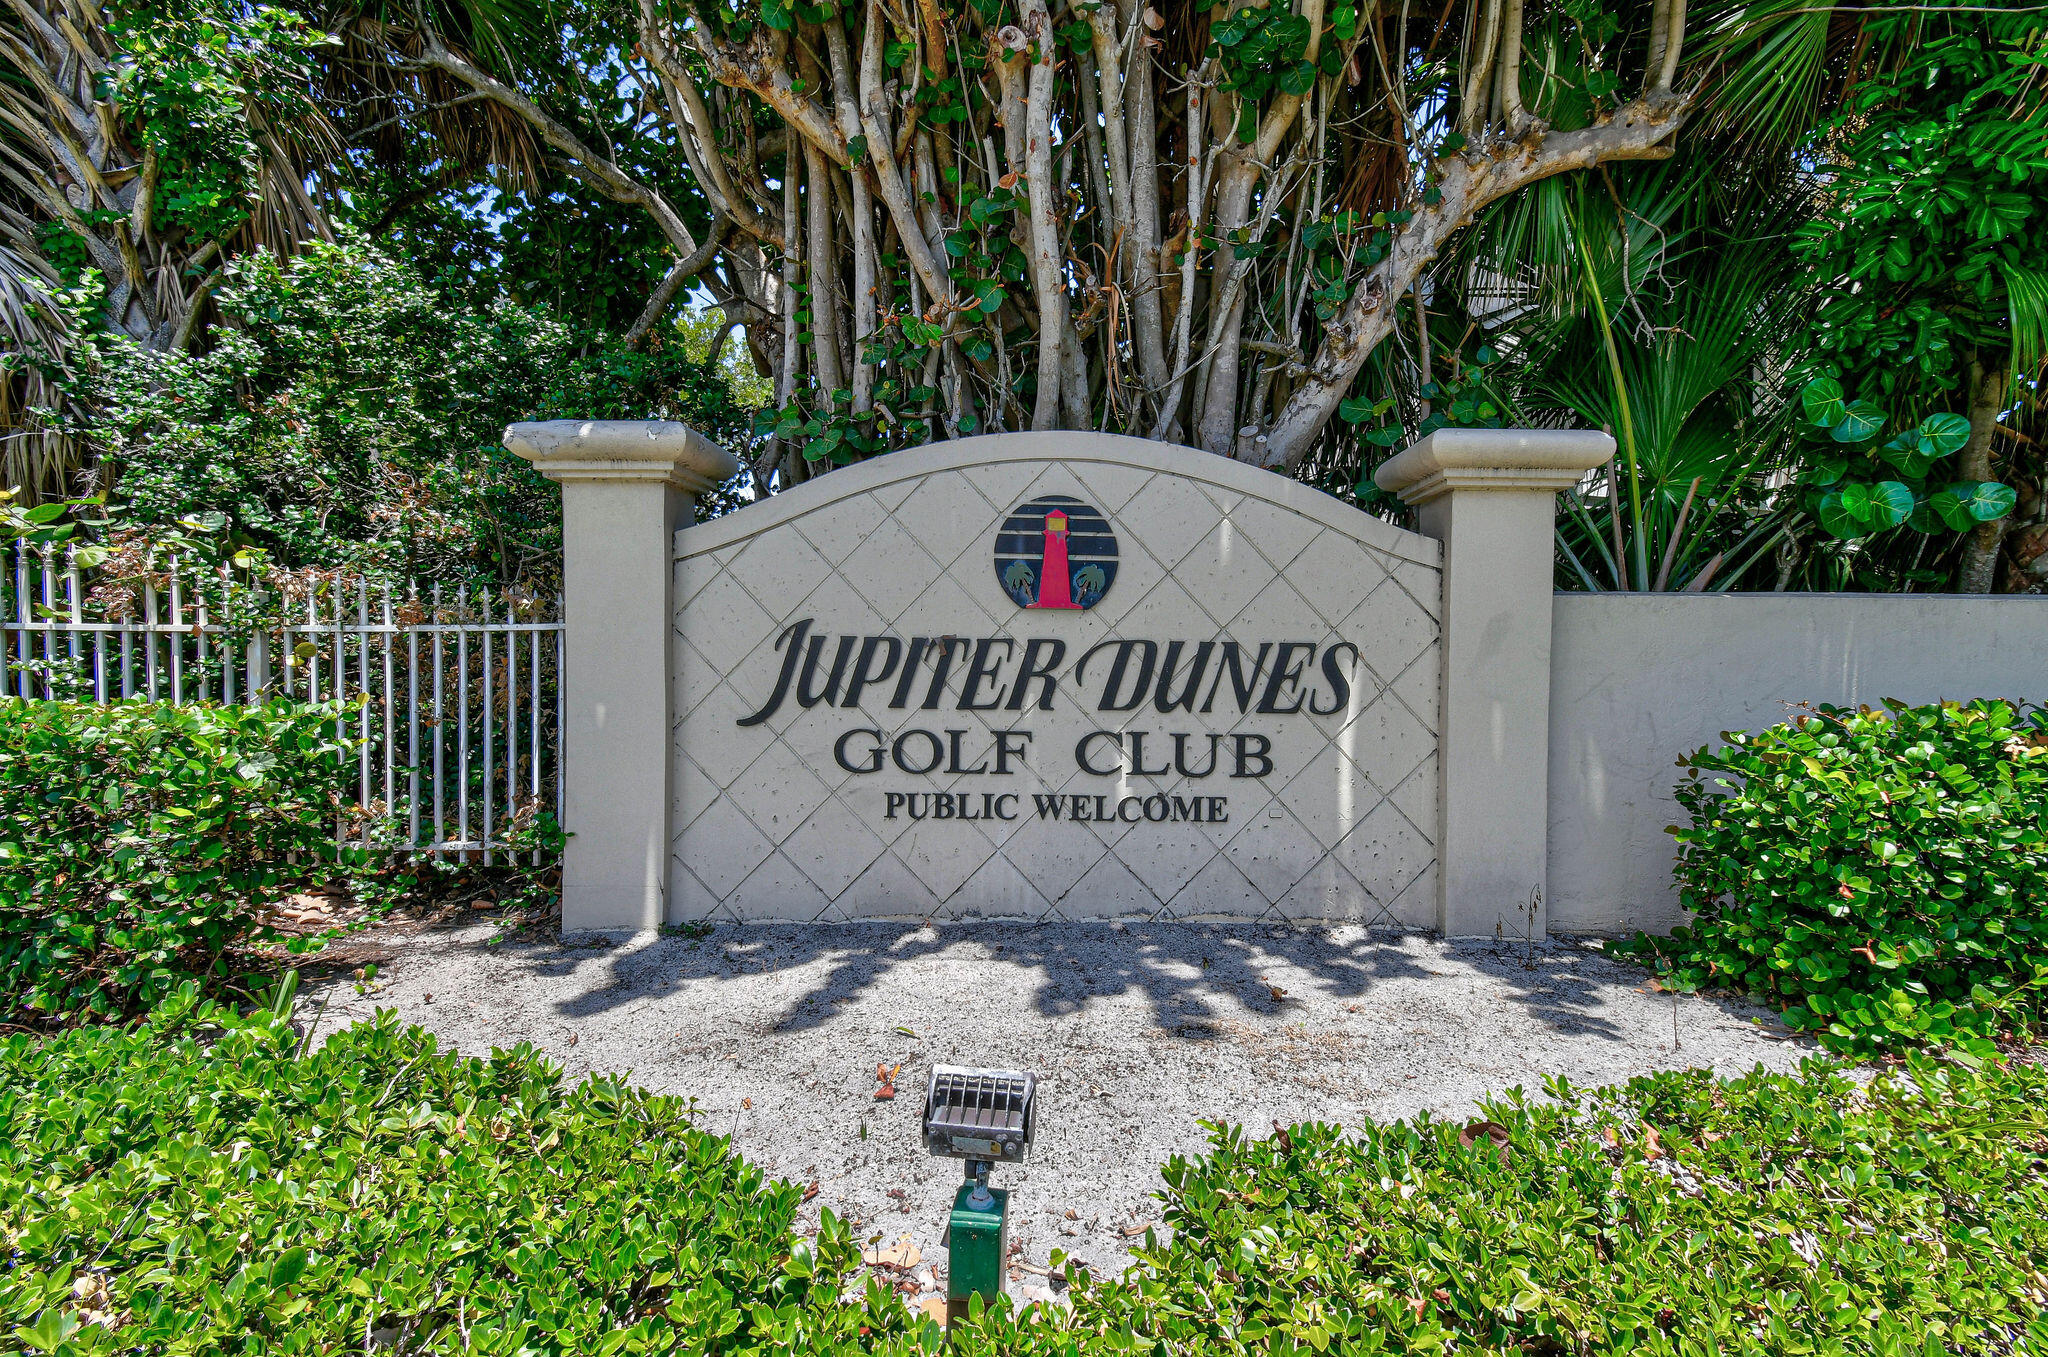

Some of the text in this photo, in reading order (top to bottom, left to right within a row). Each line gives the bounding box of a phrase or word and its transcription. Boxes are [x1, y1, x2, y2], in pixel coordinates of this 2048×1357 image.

[736, 618, 1358, 726] JUPITER DUNES
[834, 728, 1274, 778] GOLF CLUB
[883, 791, 1229, 823] PUBLIC WELCOME
